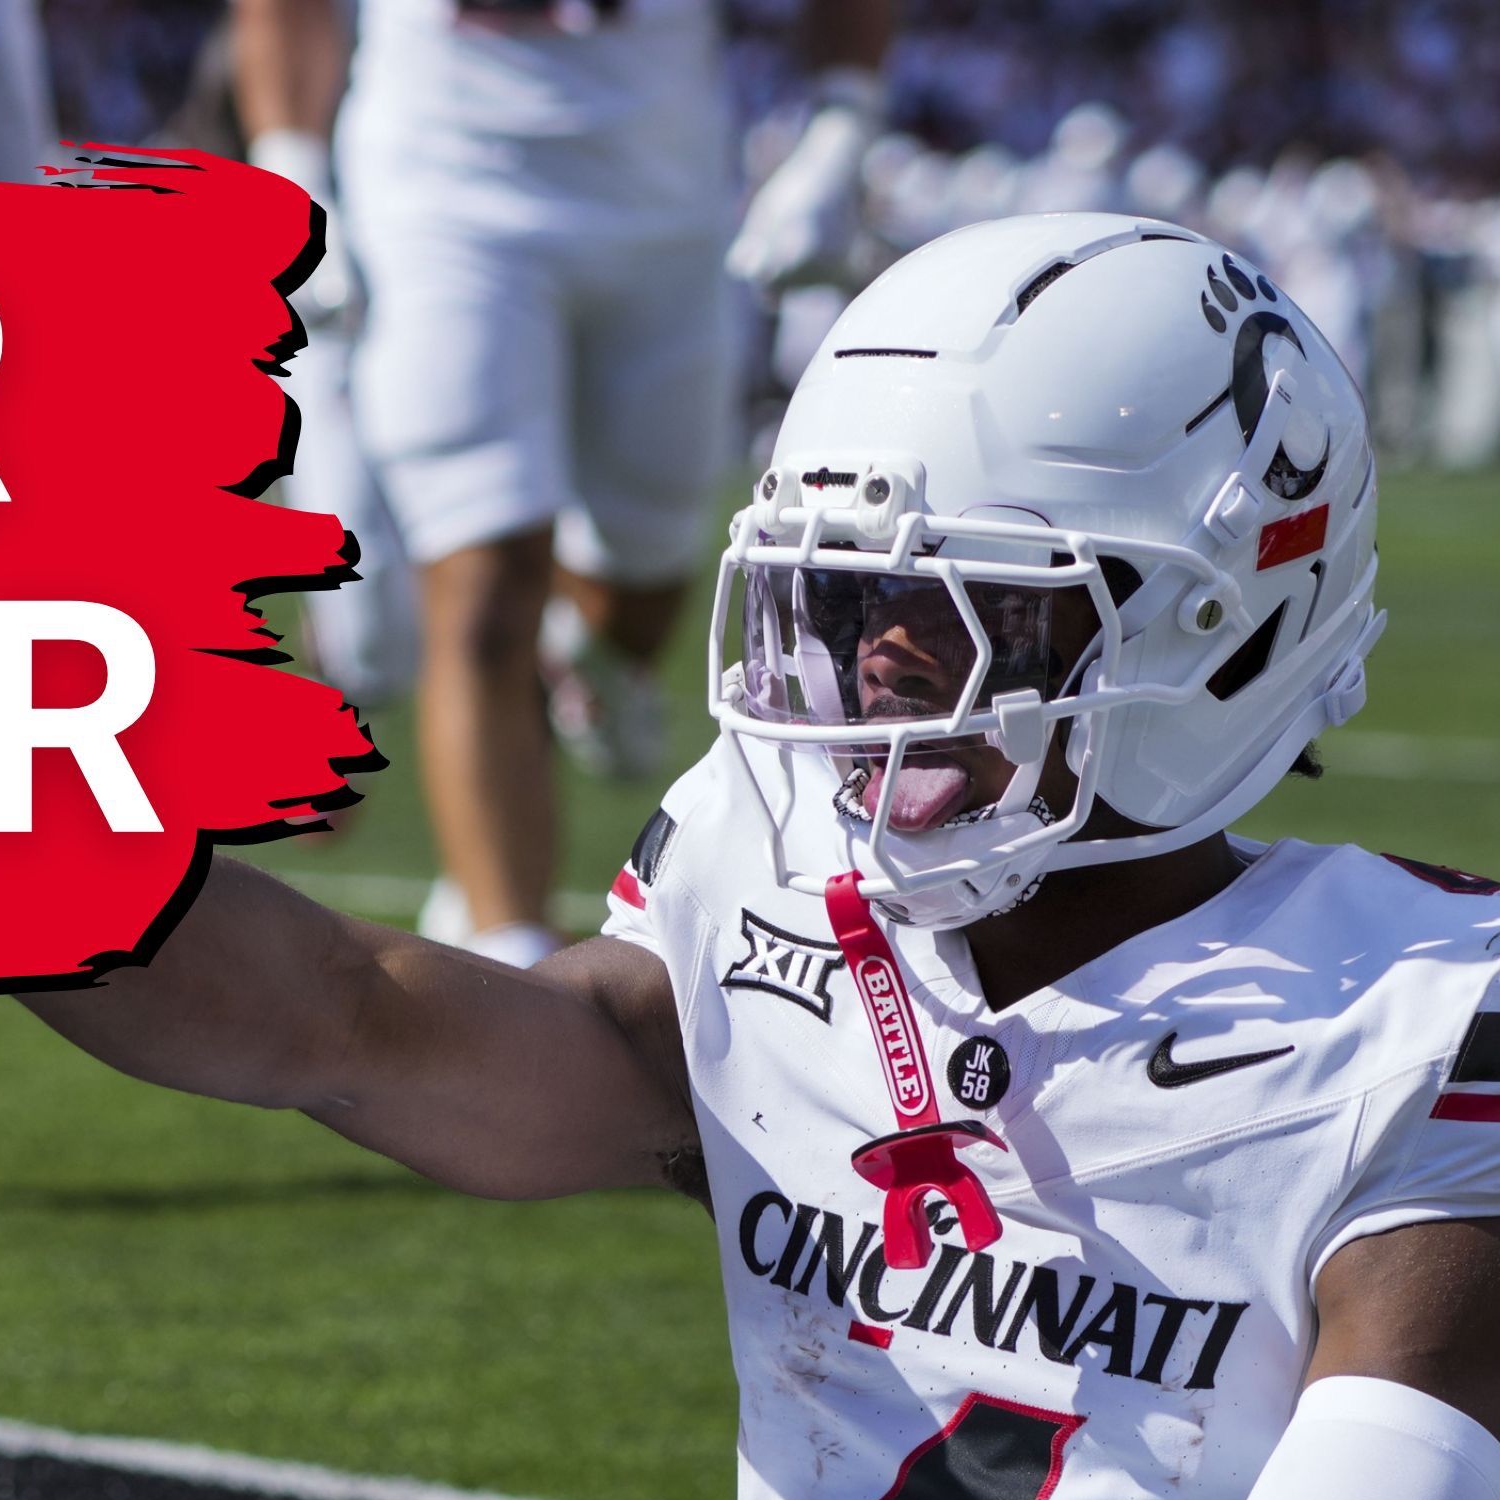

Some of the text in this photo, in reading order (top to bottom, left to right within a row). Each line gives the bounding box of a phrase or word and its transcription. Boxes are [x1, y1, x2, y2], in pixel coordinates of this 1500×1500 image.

[865, 969, 921, 1101] BATTLE
[966, 1044, 995, 1073] JK
[960, 1074, 990, 1102] 58
[738, 1190, 1250, 1390] CINCINNATI
